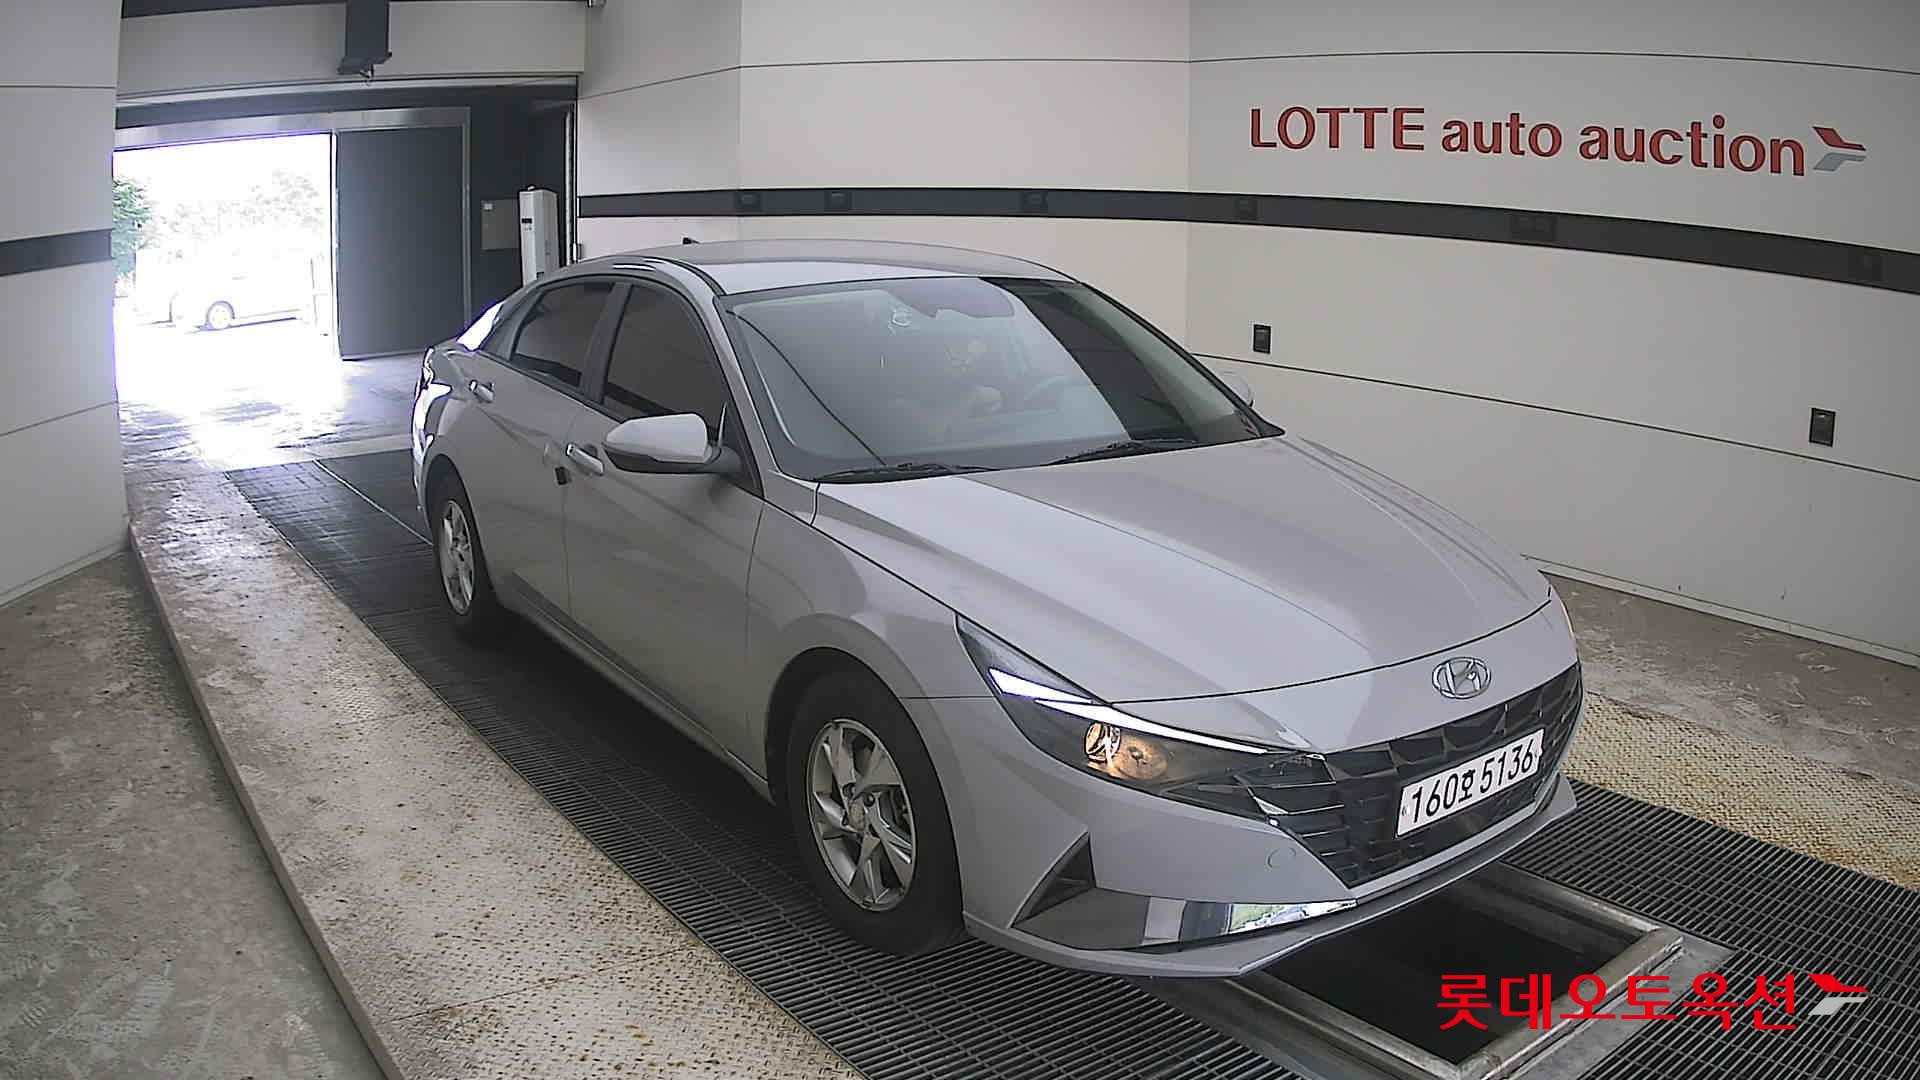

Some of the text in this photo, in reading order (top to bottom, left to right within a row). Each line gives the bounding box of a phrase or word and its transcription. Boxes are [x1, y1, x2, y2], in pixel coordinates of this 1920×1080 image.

[1250, 106, 1806, 177] LOTTE auto auction
[1479, 738, 1535, 794] 5136
